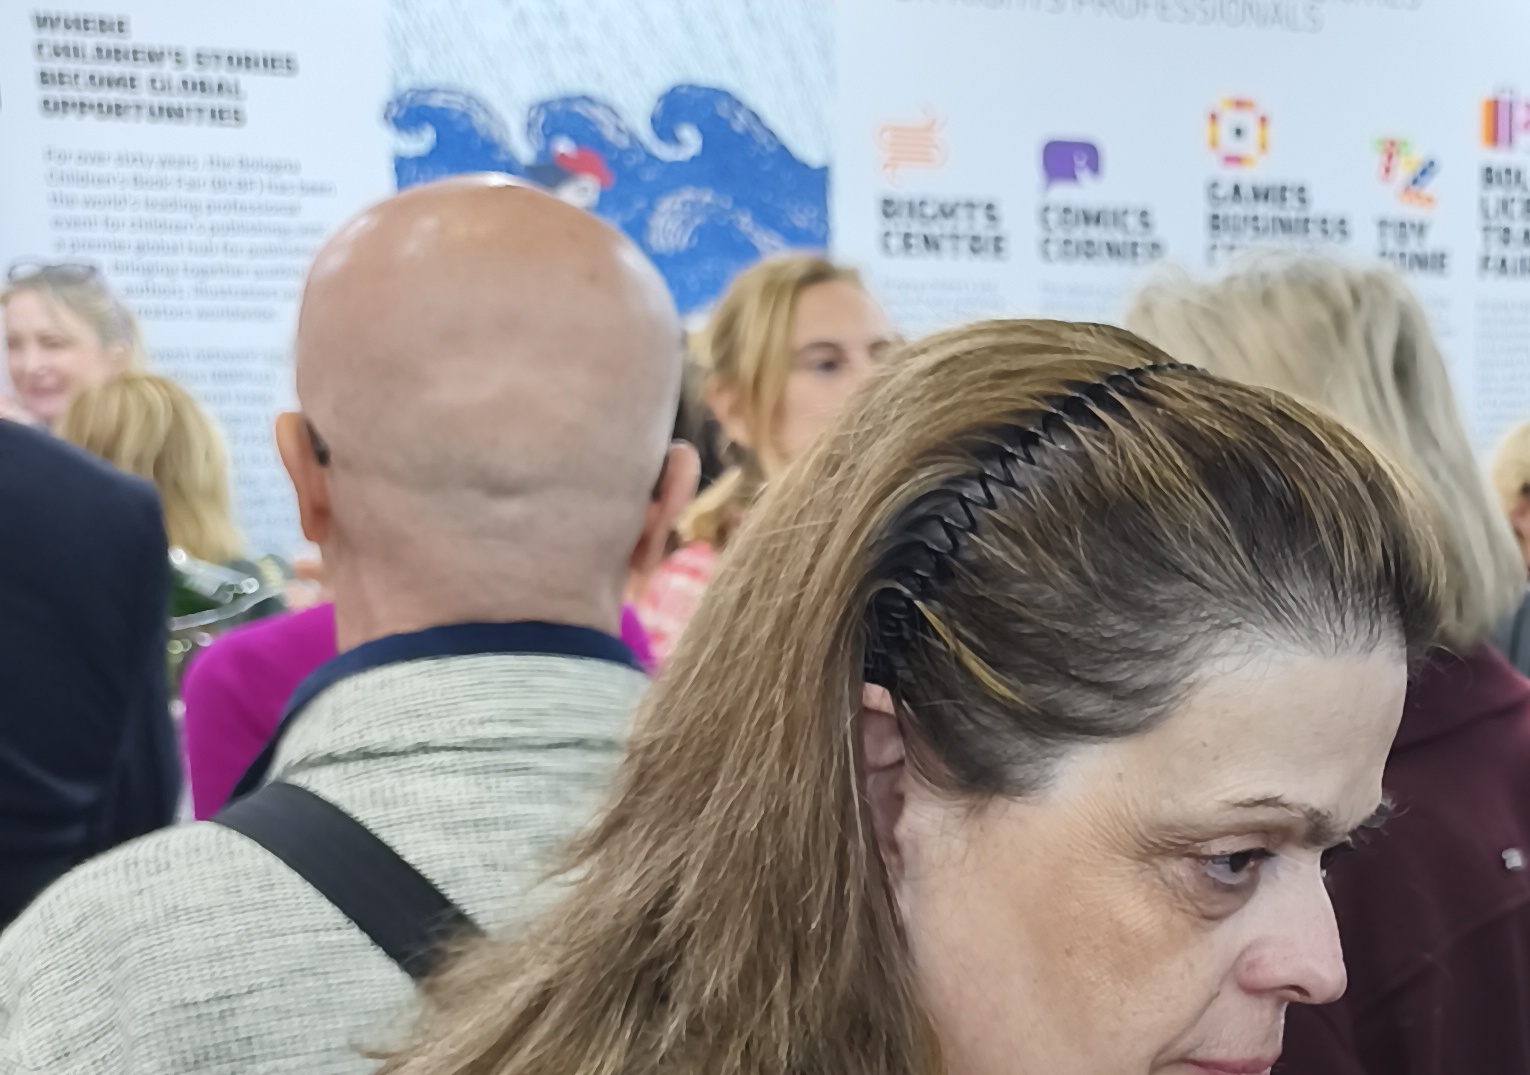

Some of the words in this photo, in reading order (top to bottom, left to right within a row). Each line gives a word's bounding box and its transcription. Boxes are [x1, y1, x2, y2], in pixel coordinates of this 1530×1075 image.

[33, 13, 128, 36] WHERE
[35, 41, 186, 67] CHILDREN'S
[193, 49, 296, 74] STORIES
[37, 68, 140, 93] BECOME
[148, 74, 243, 98] GLOBAL
[40, 96, 245, 125] OPPORTUNITIES
[1208, 181, 1309, 208] GAMES
[880, 197, 1000, 227] RIGHTS
[1038, 205, 1154, 232] COMICS
[1208, 213, 1350, 239] BUSINESS
[880, 230, 1007, 258] CENTRE
[1377, 218, 1428, 245] TOY
[1038, 236, 1163, 264] CORNER
